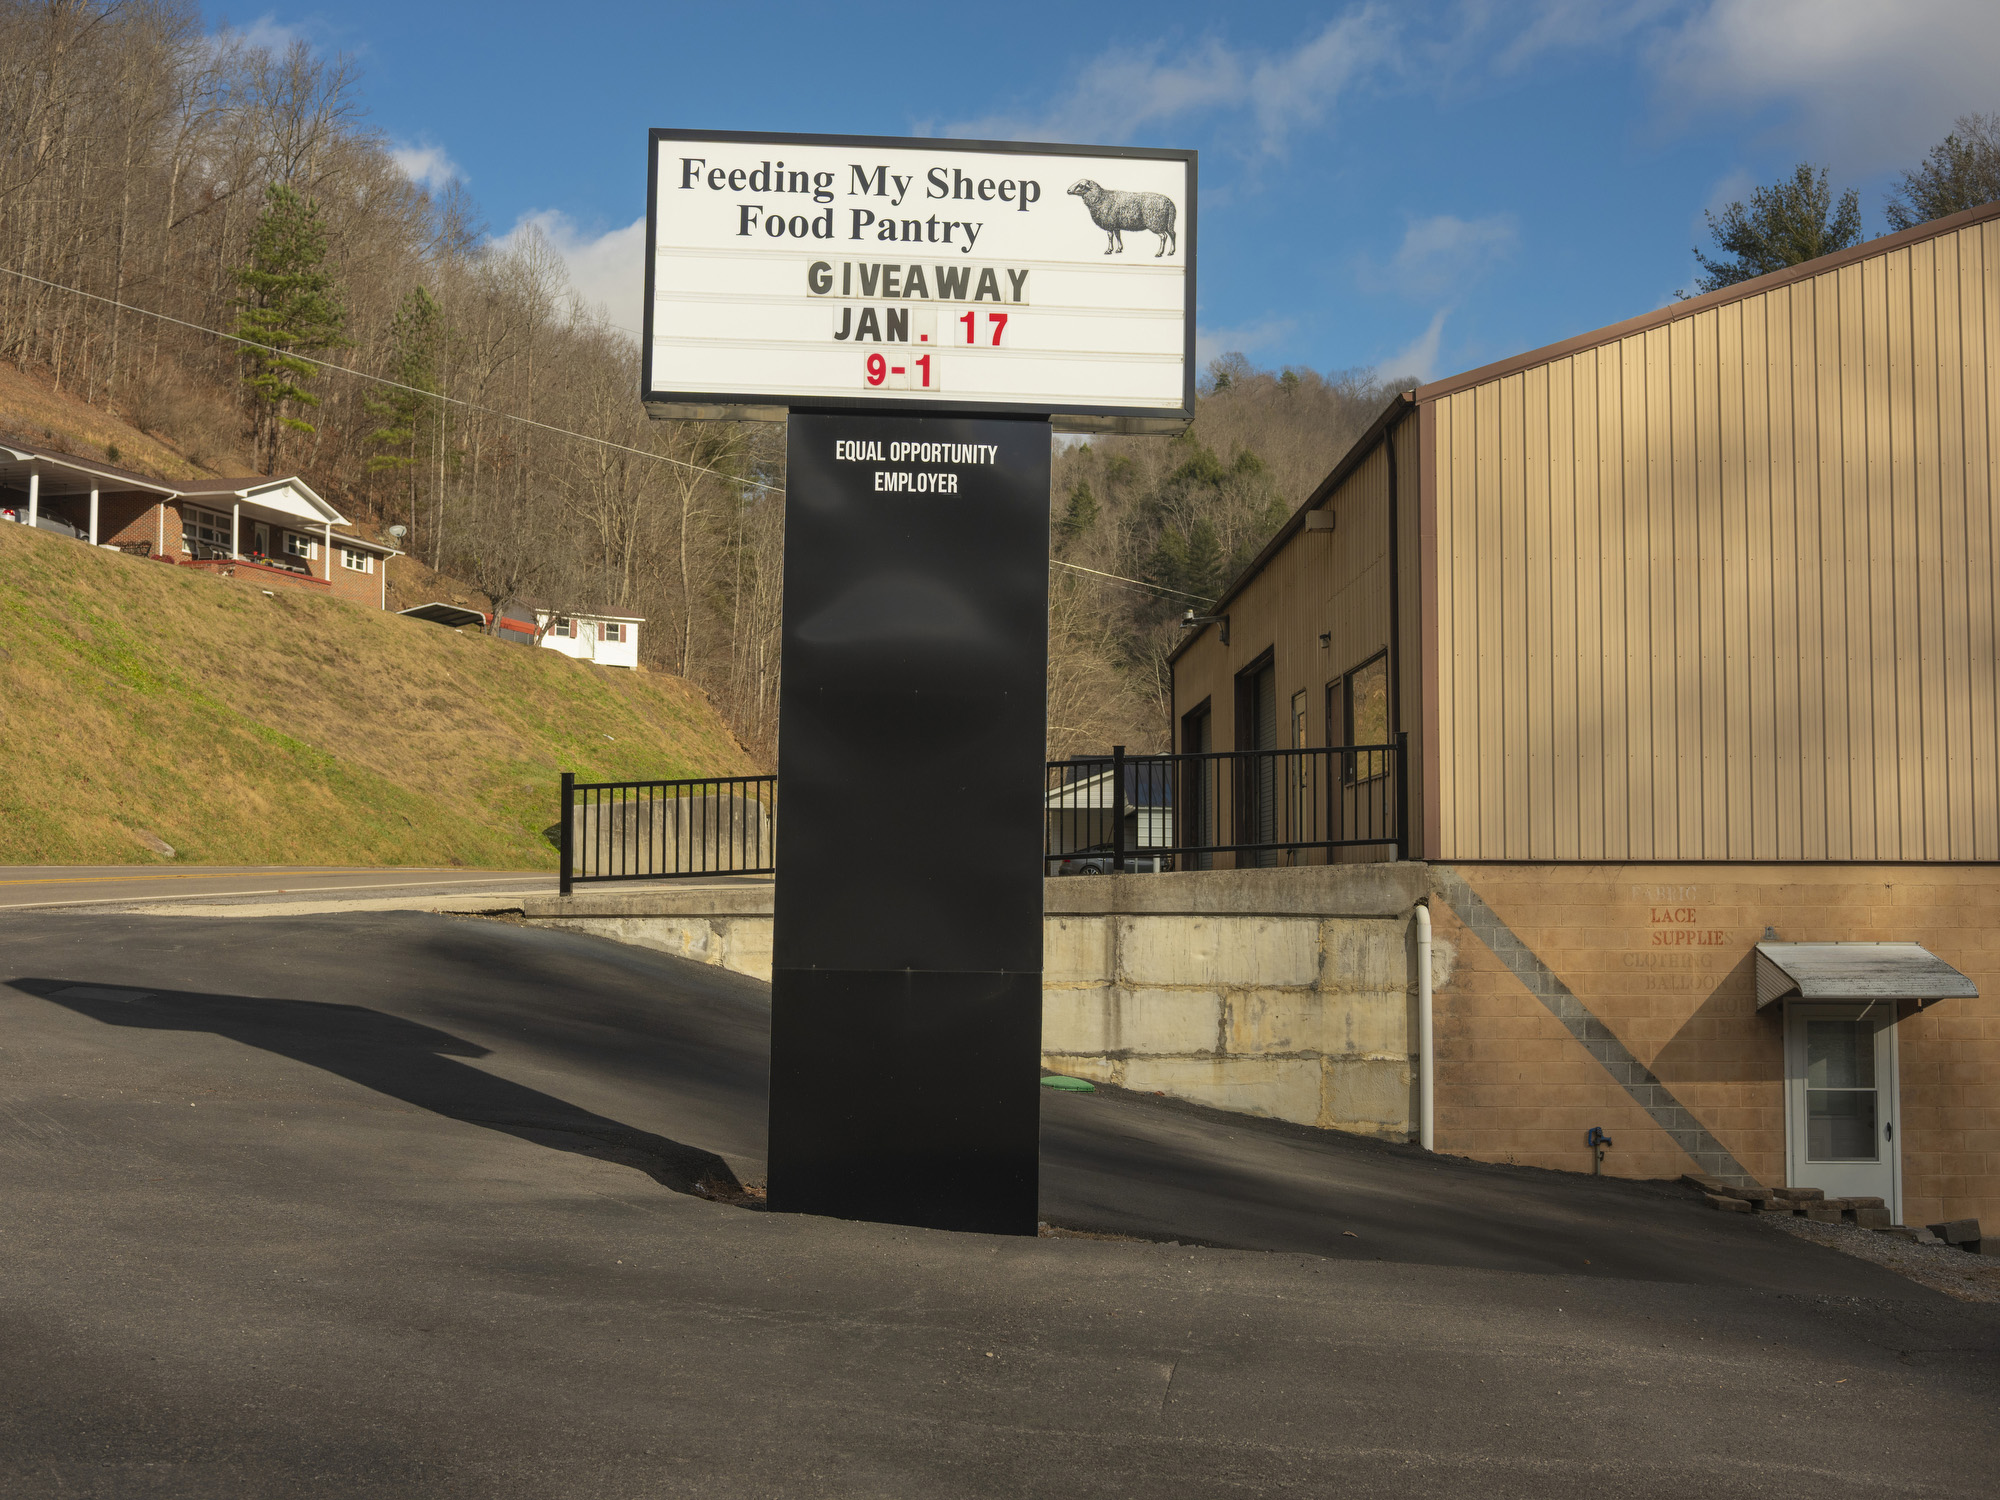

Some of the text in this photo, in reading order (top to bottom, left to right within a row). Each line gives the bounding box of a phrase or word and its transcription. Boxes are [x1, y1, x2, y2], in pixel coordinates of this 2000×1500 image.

[678, 158, 1041, 211] Feeding My Sheep
[736, 205, 983, 253] Food Pantry
[808, 261, 1029, 302] GIVEAWAY
[834, 307, 1008, 346] JAN. 17
[867, 353, 930, 387] 9-1
[836, 440, 998, 465] EQUAL OPPORTUNITY
[874, 471, 958, 493] EMPLOYER
[1632, 886, 1697, 901] FABRIC
[1651, 908, 1697, 923] LACE
[1623, 952, 1713, 967] CLOTHING
